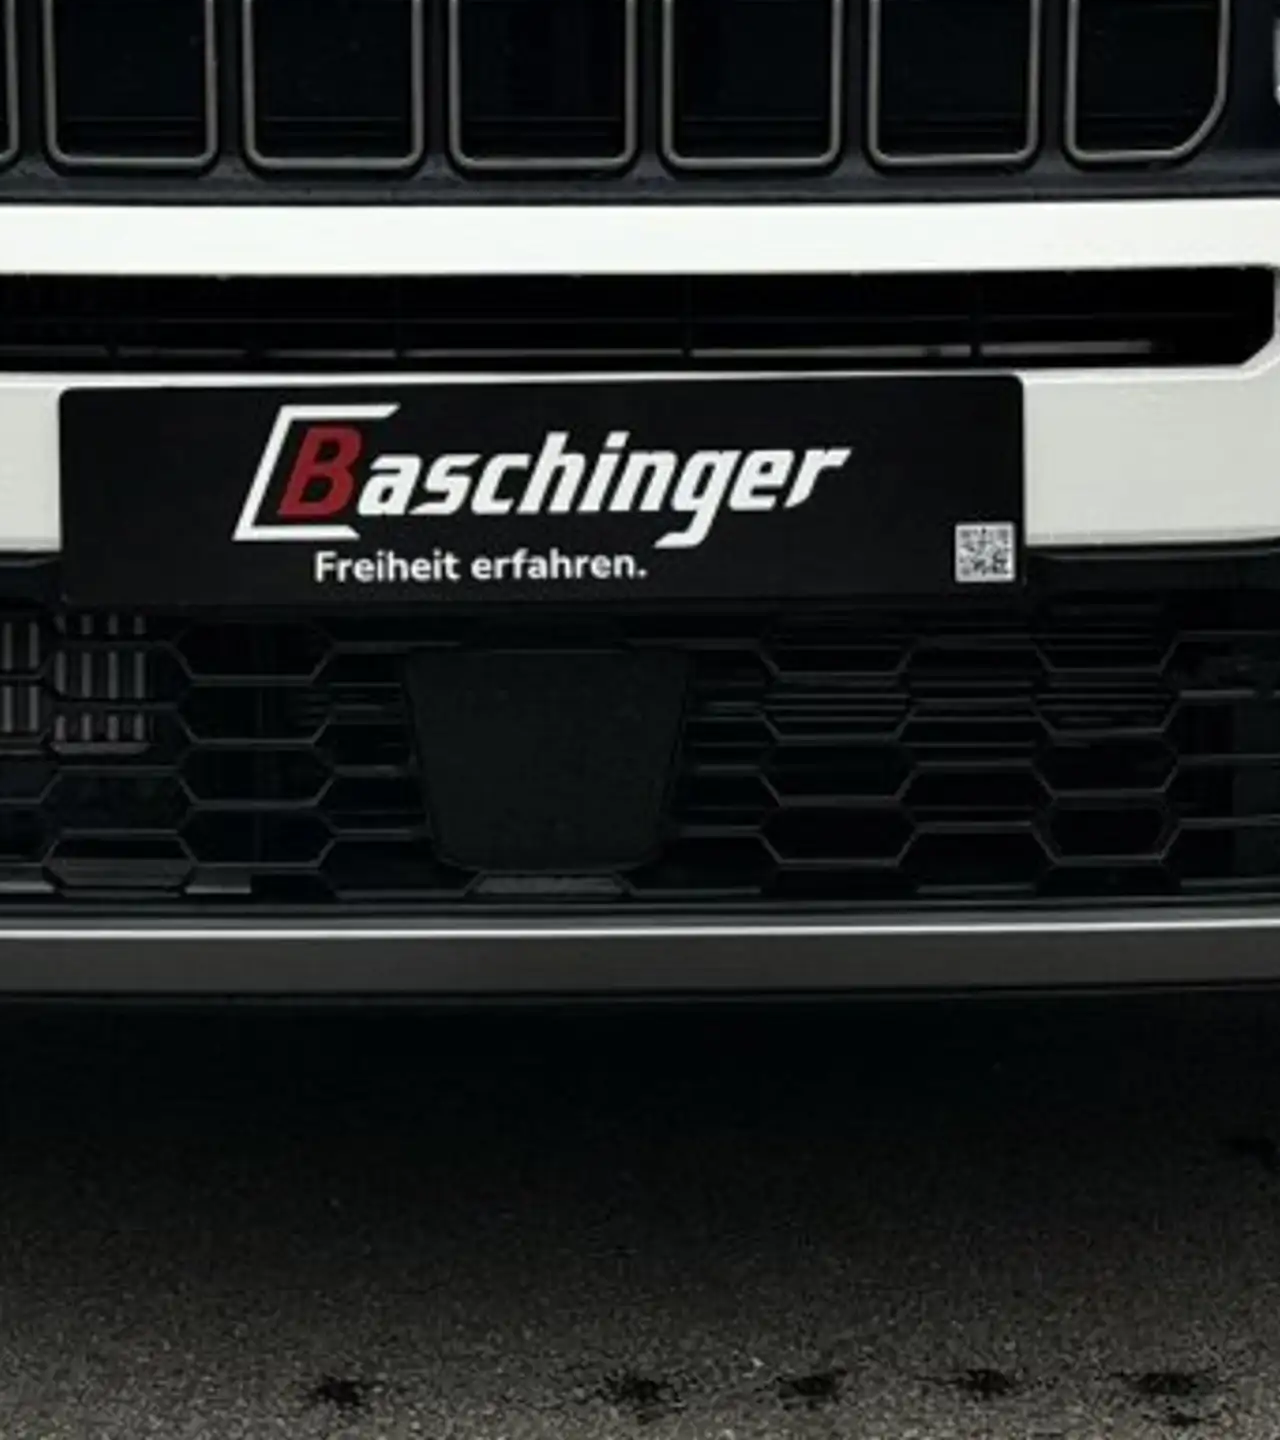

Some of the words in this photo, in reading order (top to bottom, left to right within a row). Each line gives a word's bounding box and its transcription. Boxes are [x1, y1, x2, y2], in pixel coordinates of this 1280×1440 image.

[277, 426, 852, 549] Baschinger
[314, 550, 461, 583] Freiheit
[471, 548, 648, 581] erfahren.
